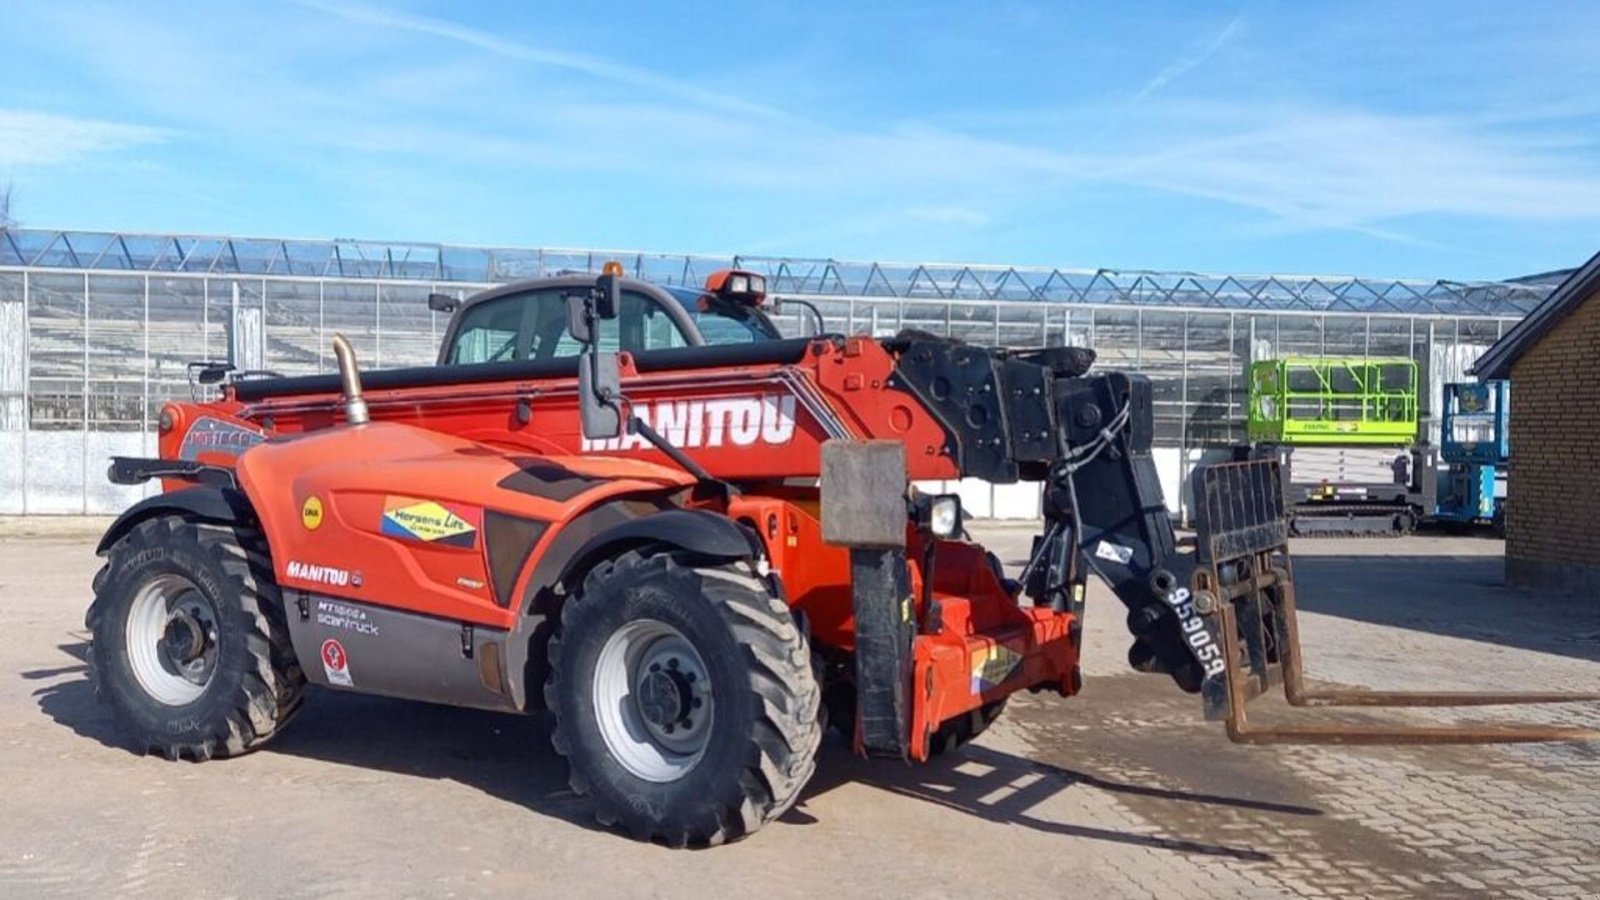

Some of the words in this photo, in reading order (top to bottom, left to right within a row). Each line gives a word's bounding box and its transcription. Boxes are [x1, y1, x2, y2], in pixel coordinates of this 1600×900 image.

[581, 395, 796, 451] ANITOU
[287, 561, 349, 586] MANITOU
[1168, 587, 1225, 679] 959059
